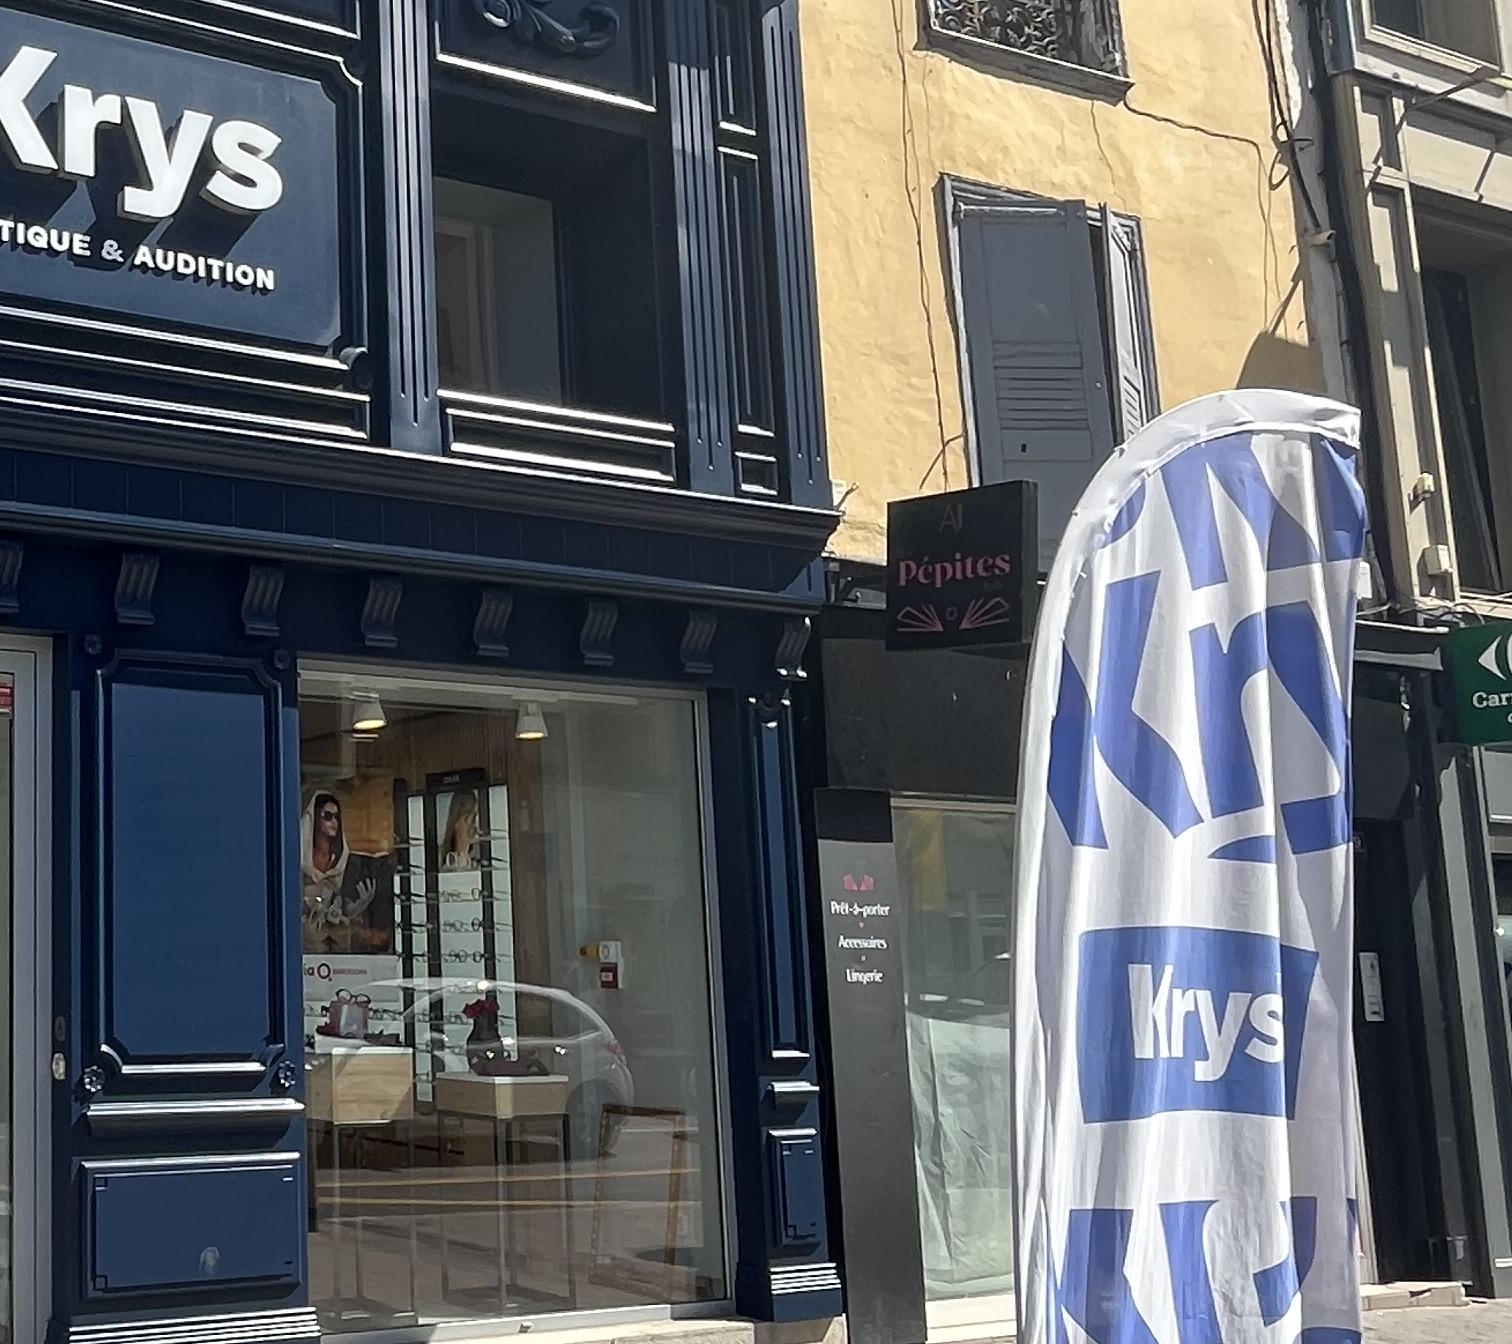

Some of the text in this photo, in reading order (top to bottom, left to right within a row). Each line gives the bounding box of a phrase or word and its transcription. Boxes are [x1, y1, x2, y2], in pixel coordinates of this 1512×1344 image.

[100, 239, 125, 263] &
[133, 244, 275, 291] AUDITION
[898, 552, 1011, 588] Pépites
[846, 968, 884, 985] Lingerie
[1127, 963, 1284, 1082] Krys
